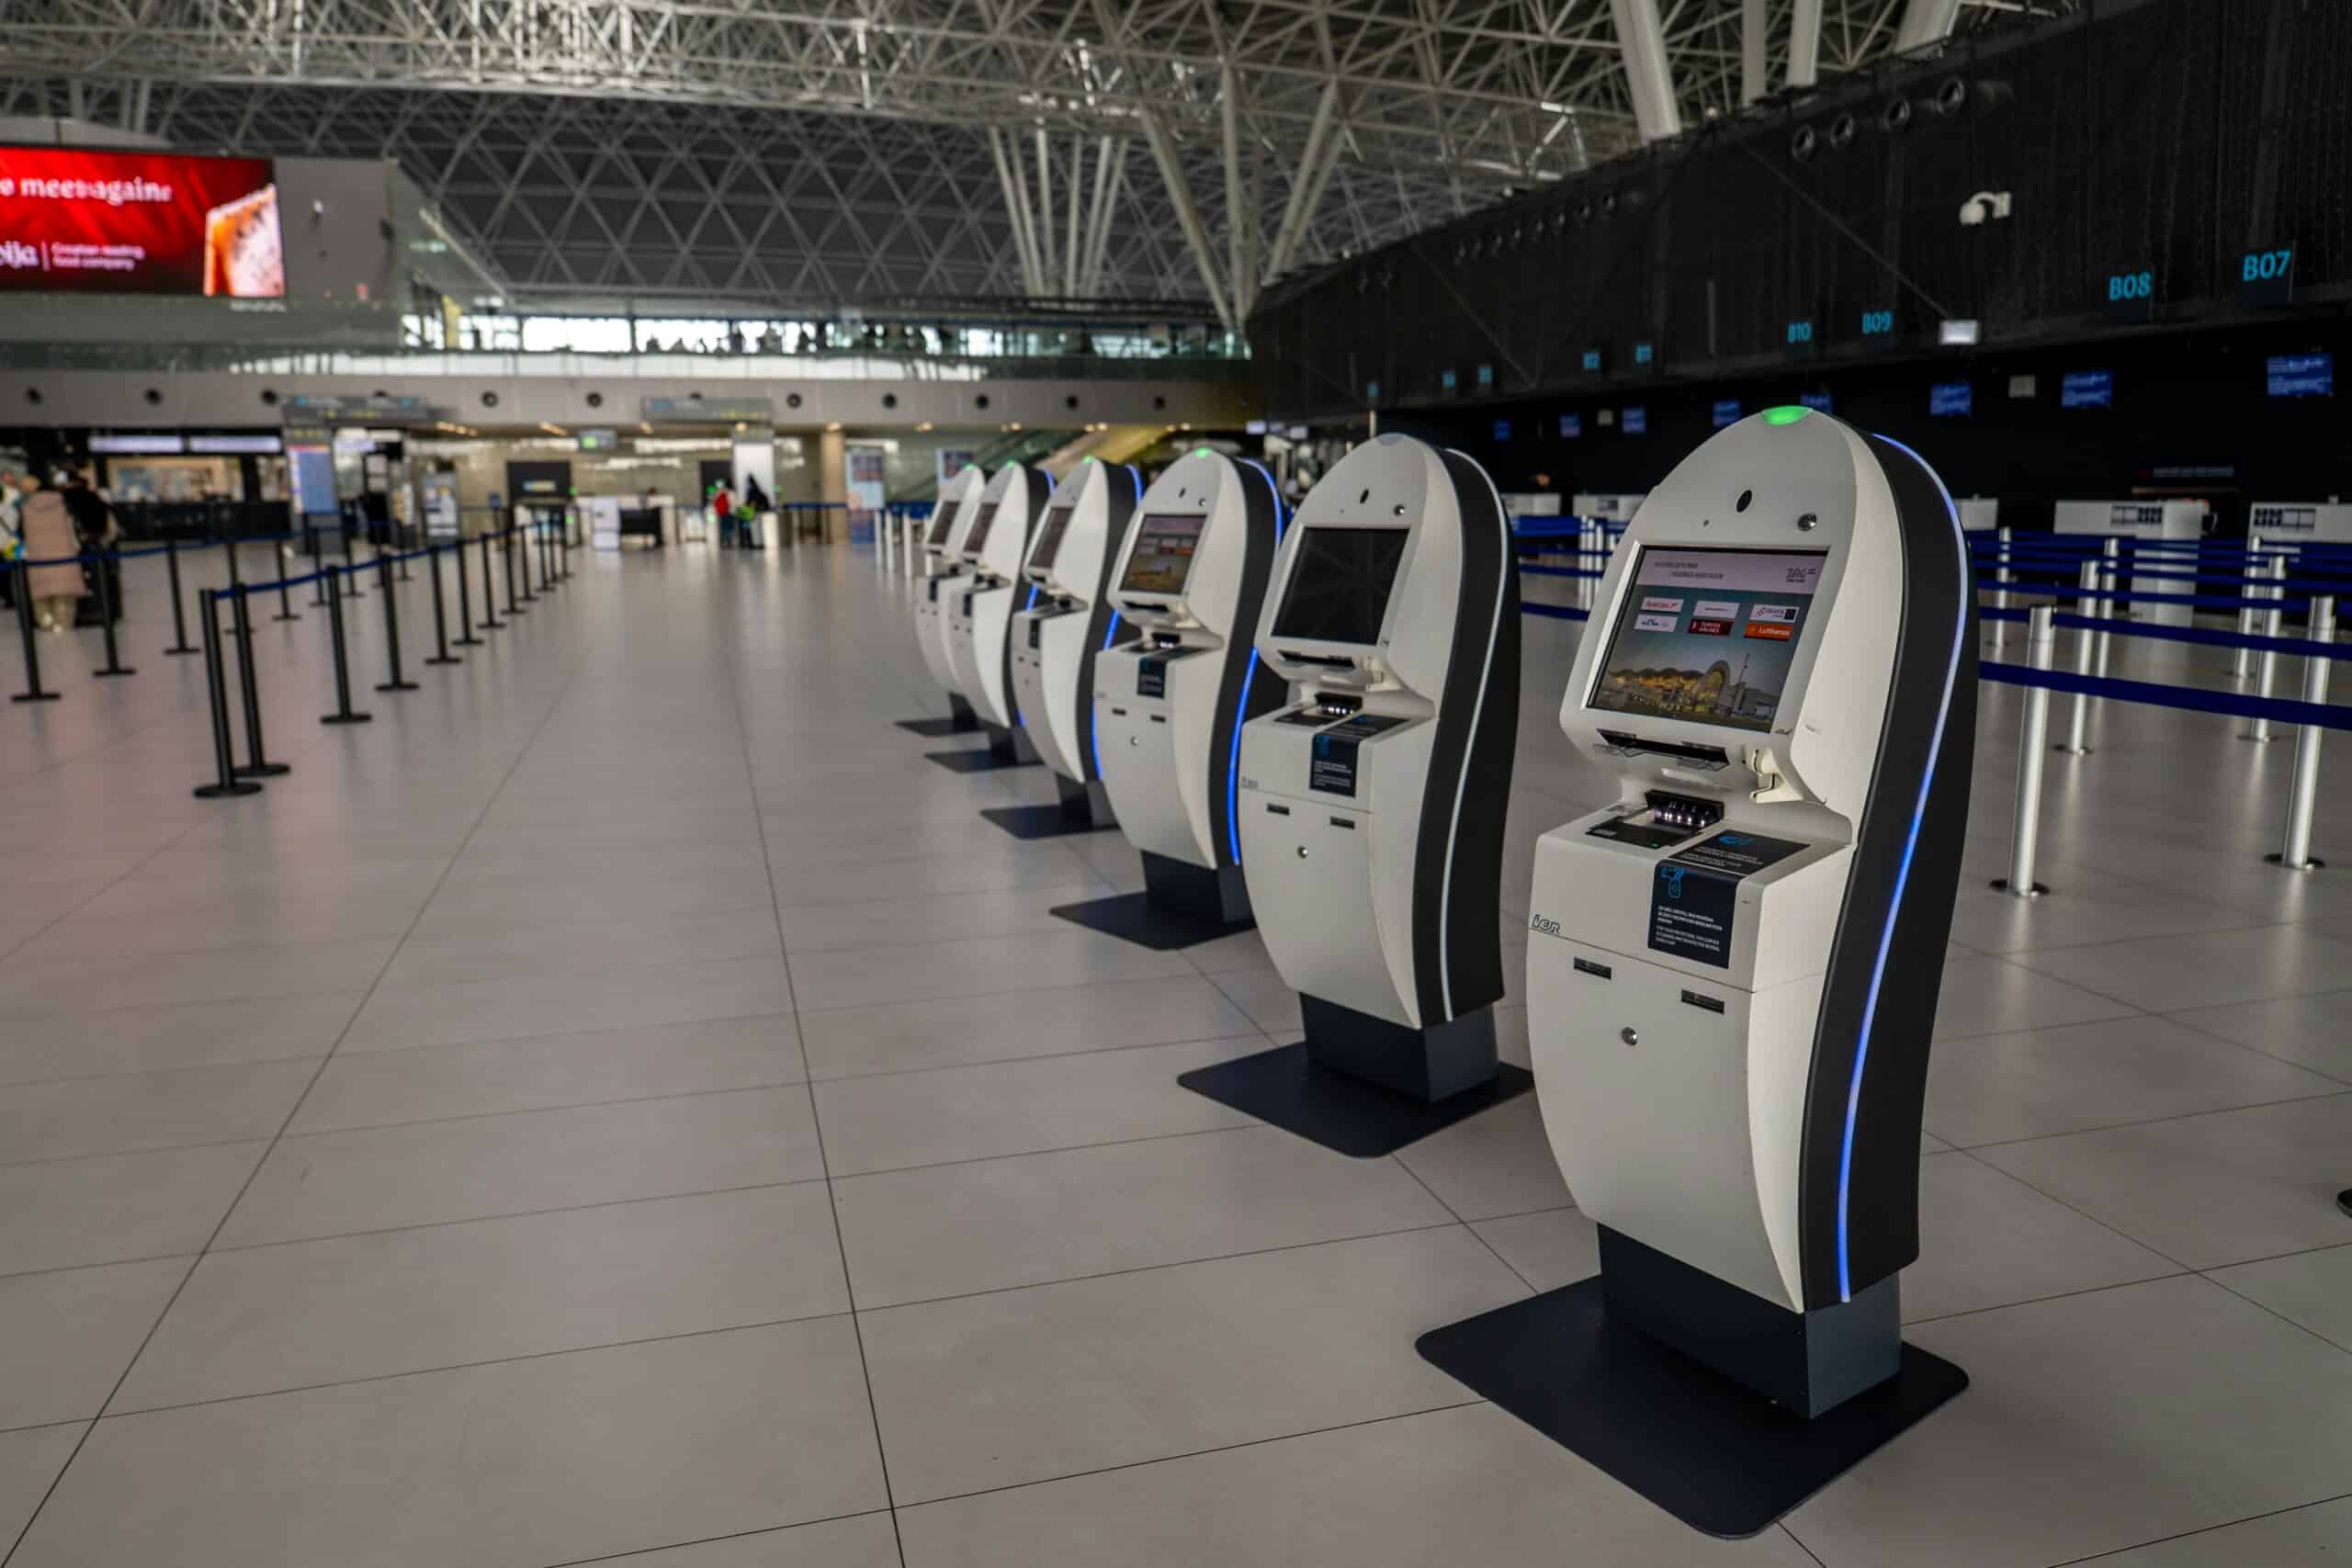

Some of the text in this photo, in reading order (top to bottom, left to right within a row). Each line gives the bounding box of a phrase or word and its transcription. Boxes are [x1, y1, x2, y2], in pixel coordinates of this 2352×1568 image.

[2242, 249, 2291, 281] B07
[2109, 271, 2151, 301] B08
[1862, 311, 1894, 334] B09
